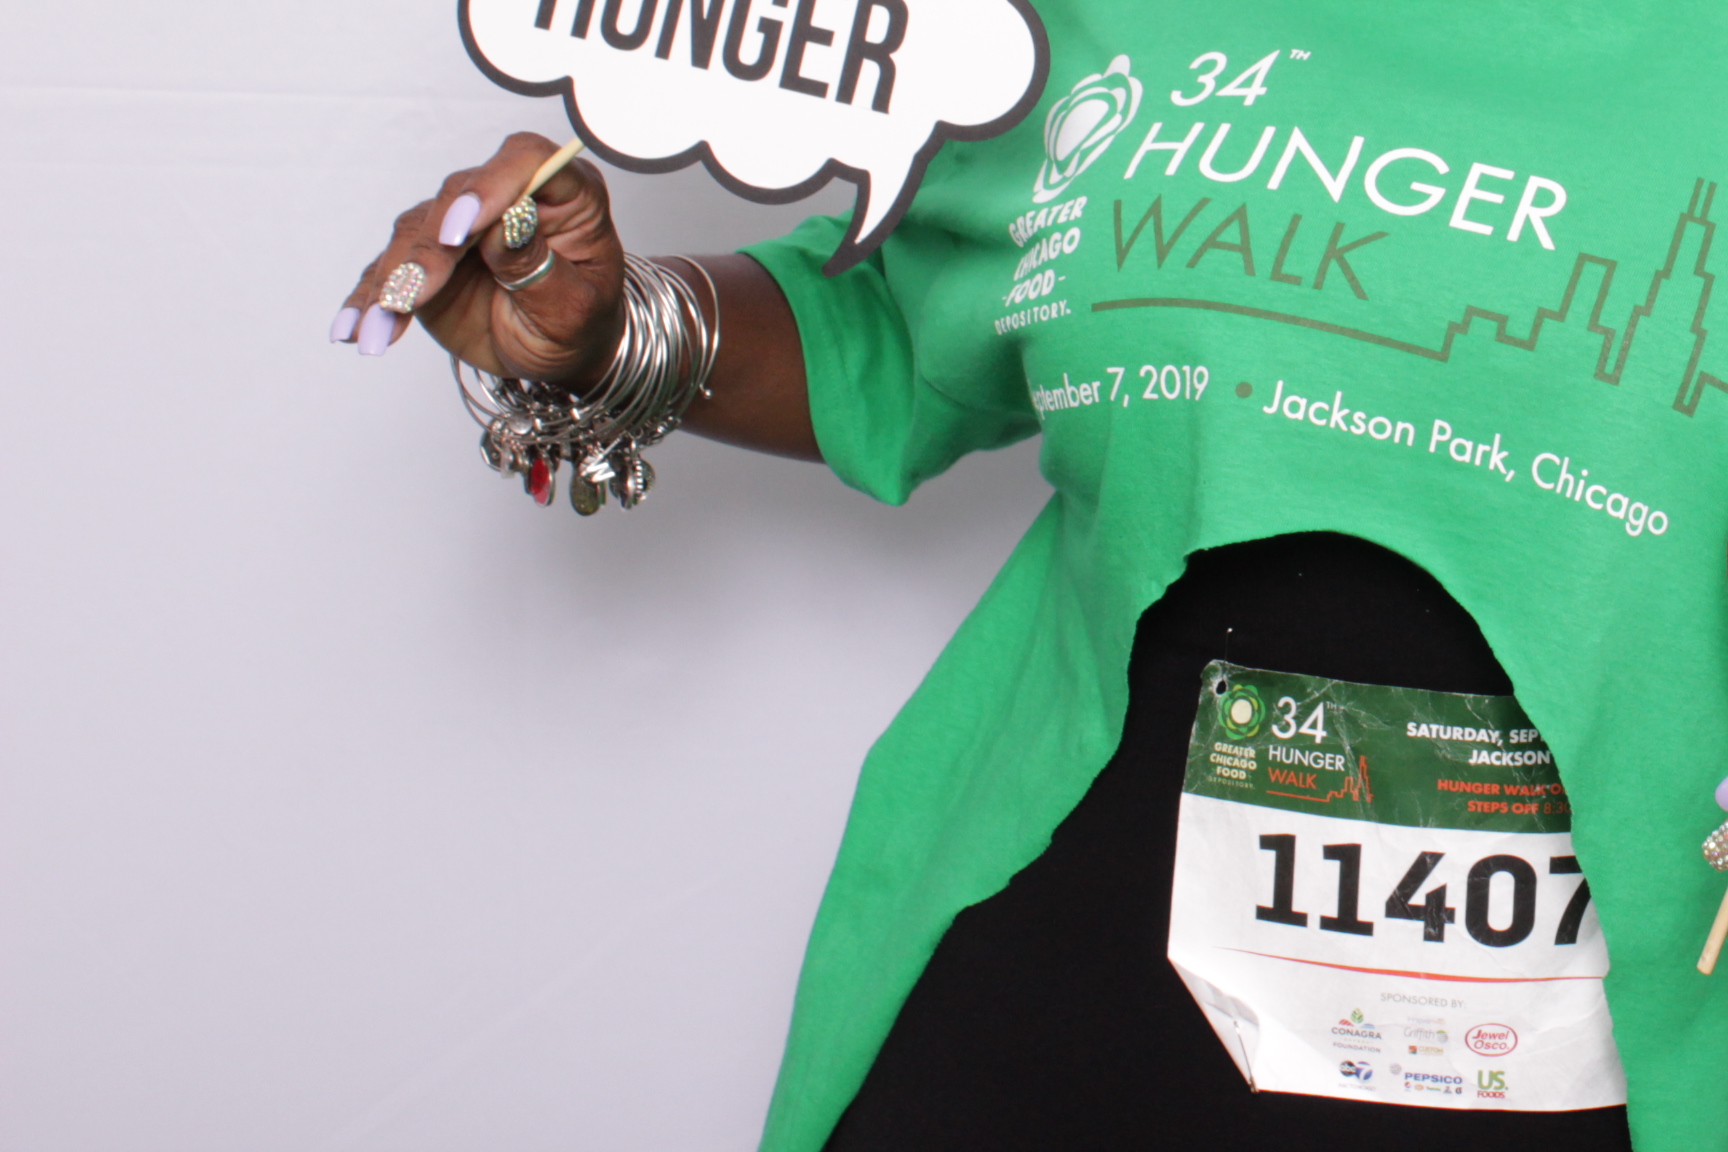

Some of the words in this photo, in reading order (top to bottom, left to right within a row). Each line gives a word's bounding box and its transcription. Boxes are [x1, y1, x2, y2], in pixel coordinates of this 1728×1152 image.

[1123, 122, 1567, 250] HUNGER
[1008, 195, 1087, 248] GREATER
[1113, 193, 1391, 301] WALK
[1030, 372, 1101, 420] eptember
[1106, 366, 1129, 408] 7,
[1139, 364, 1210, 401] 2019
[1263, 380, 1414, 447] Jackson
[1429, 419, 1515, 482] Park,
[1531, 453, 1669, 537] Chicago
[1406, 721, 1503, 747] SATURDAY,
[1509, 728, 1545, 744] SEP
[1214, 742, 1256, 759] GREATER
[1268, 745, 1345, 772] HUNGER
[1469, 750, 1550, 766] JACKSON
[1209, 753, 1257, 770] CHICAGO
[1216, 766, 1247, 780] FOOD
[1267, 767, 1318, 790] WALK
[1437, 779, 1500, 795] HUNGER
[1503, 784, 1546, 796] WALK
[1467, 800, 1509, 814] STEPS
[1512, 803, 1539, 815] OFF
[1255, 832, 1592, 949] 11407
[1380, 993, 1448, 1008] SPONSORED
[1331, 1027, 1382, 1040] CONAGRA
[1472, 1029, 1510, 1040] Jewel
[1333, 1042, 1381, 1054] FOUNDATION
[1404, 1072, 1463, 1085] PEPSICO
[1477, 1090, 1506, 1099] FOODS
